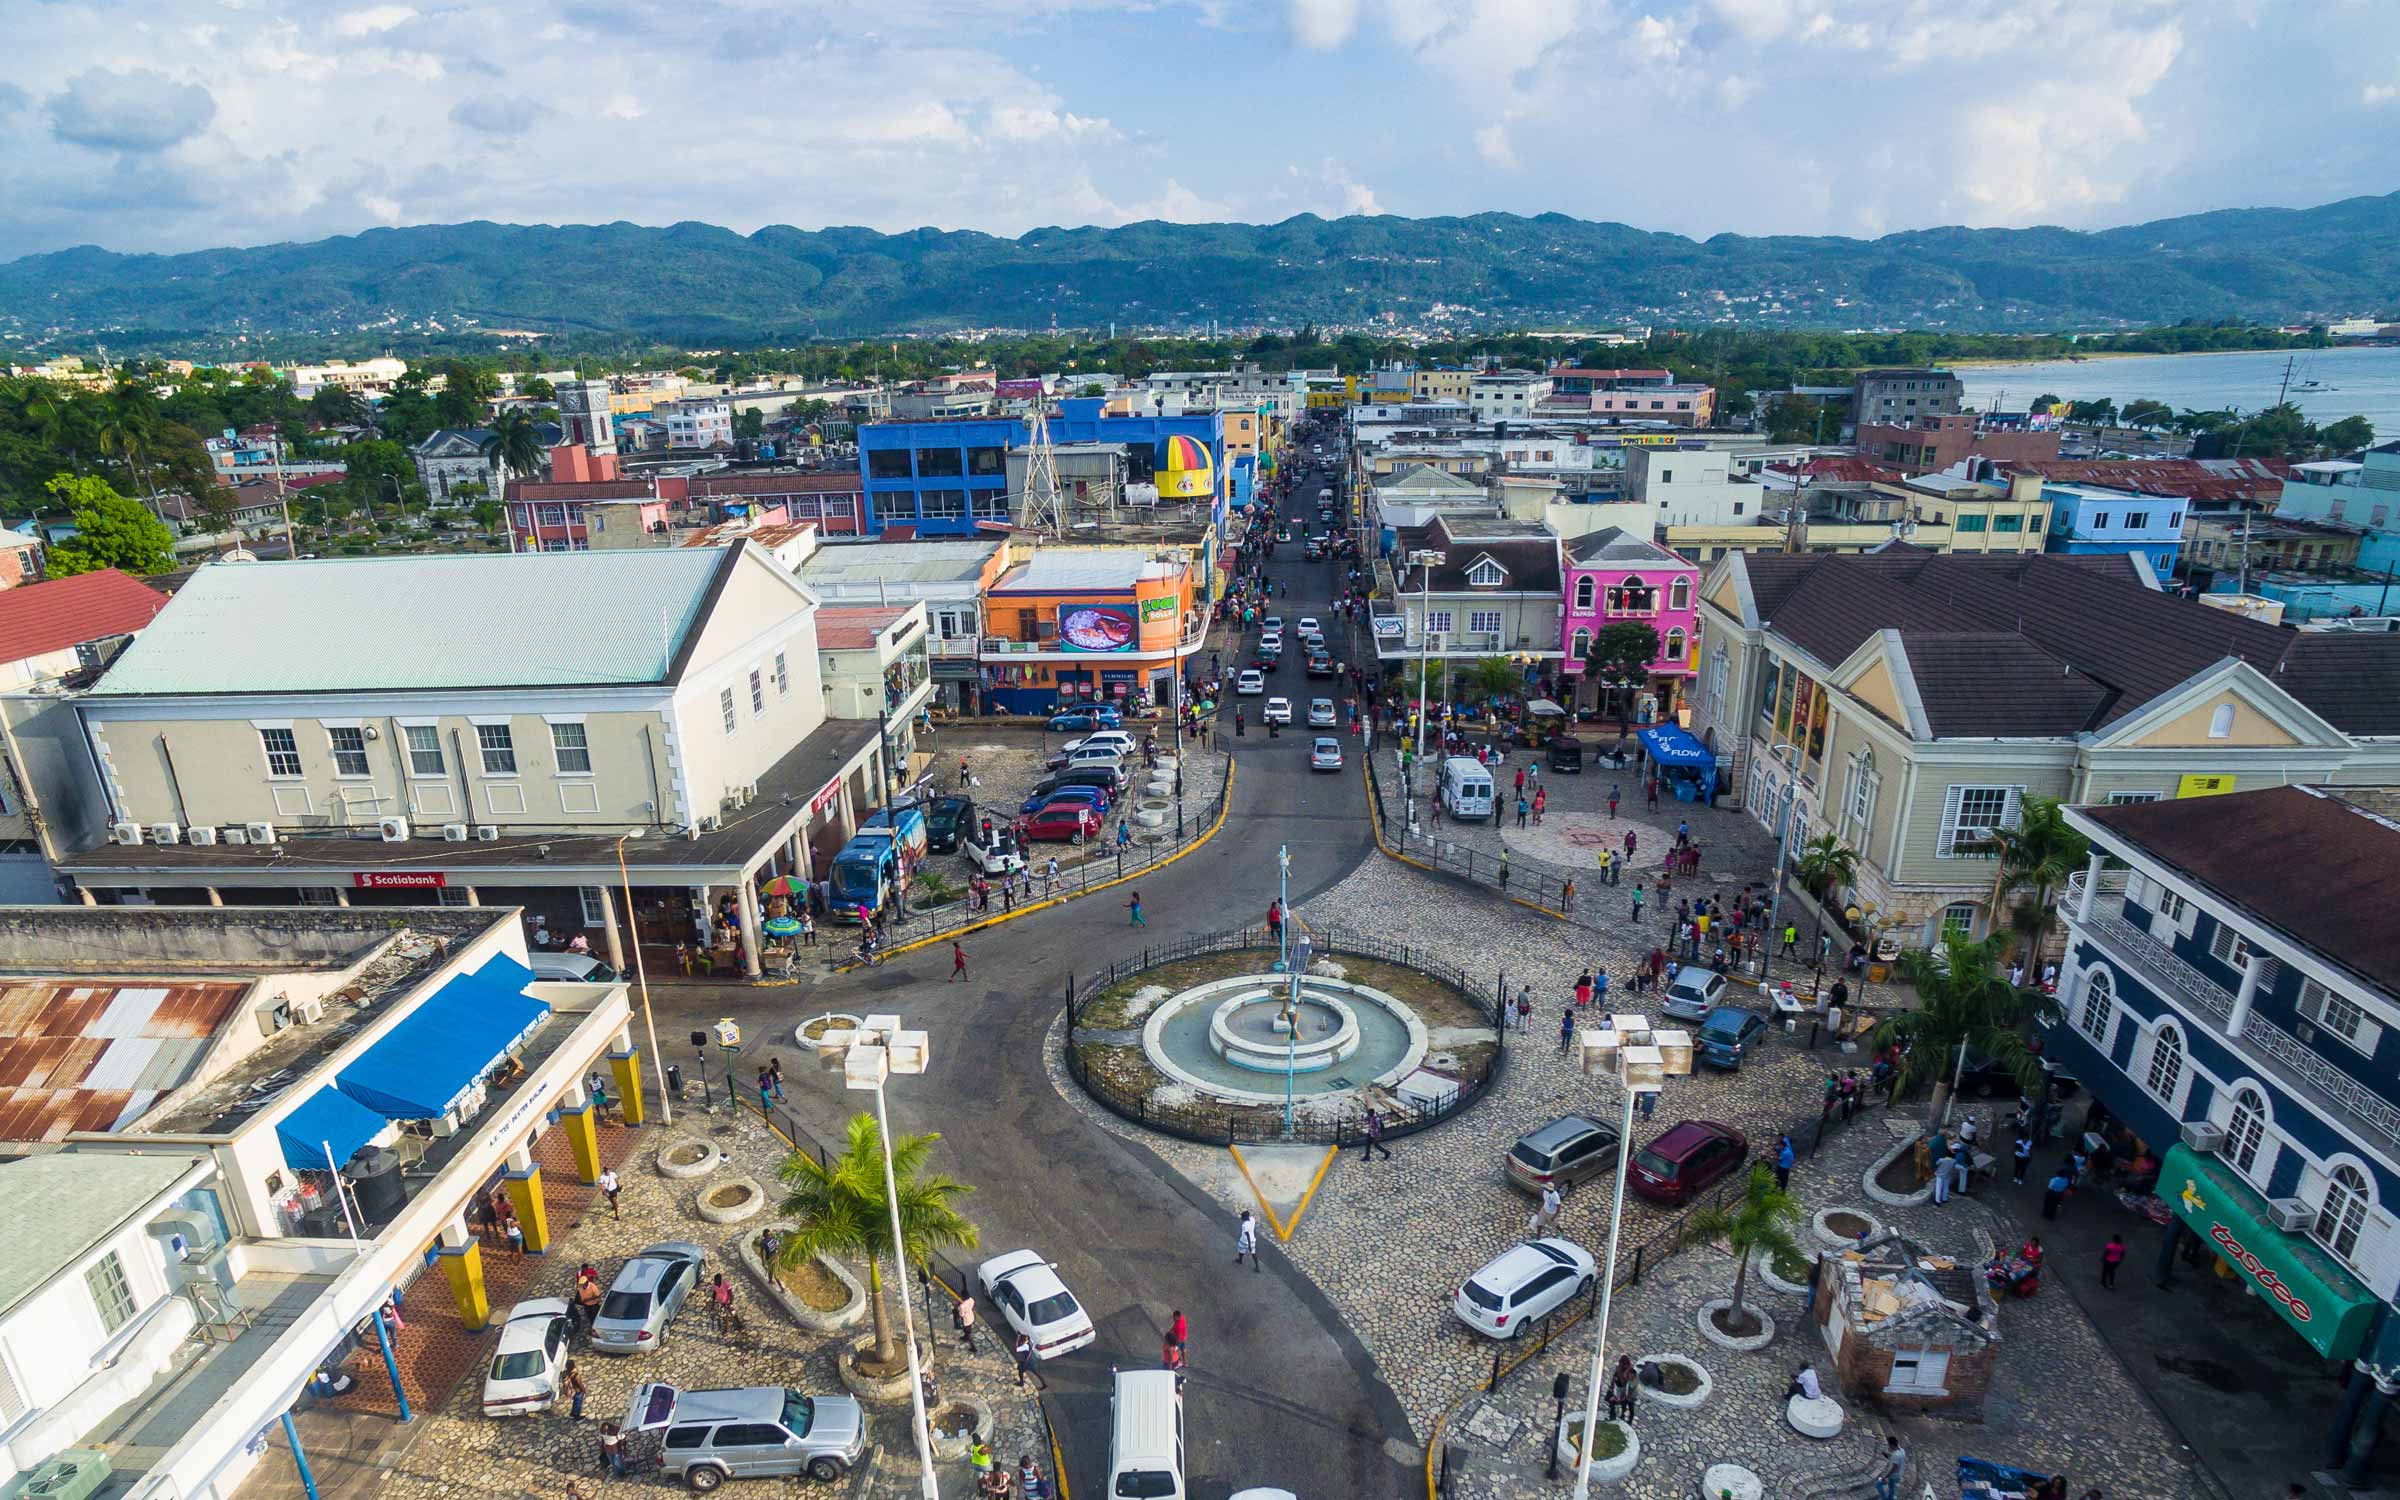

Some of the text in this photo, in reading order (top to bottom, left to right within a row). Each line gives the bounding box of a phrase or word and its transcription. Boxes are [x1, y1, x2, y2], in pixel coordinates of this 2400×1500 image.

[1671, 749, 1700, 757] FLOW
[375, 875, 437, 885] Scotiabank
[2210, 1220, 2312, 1322] tastee
